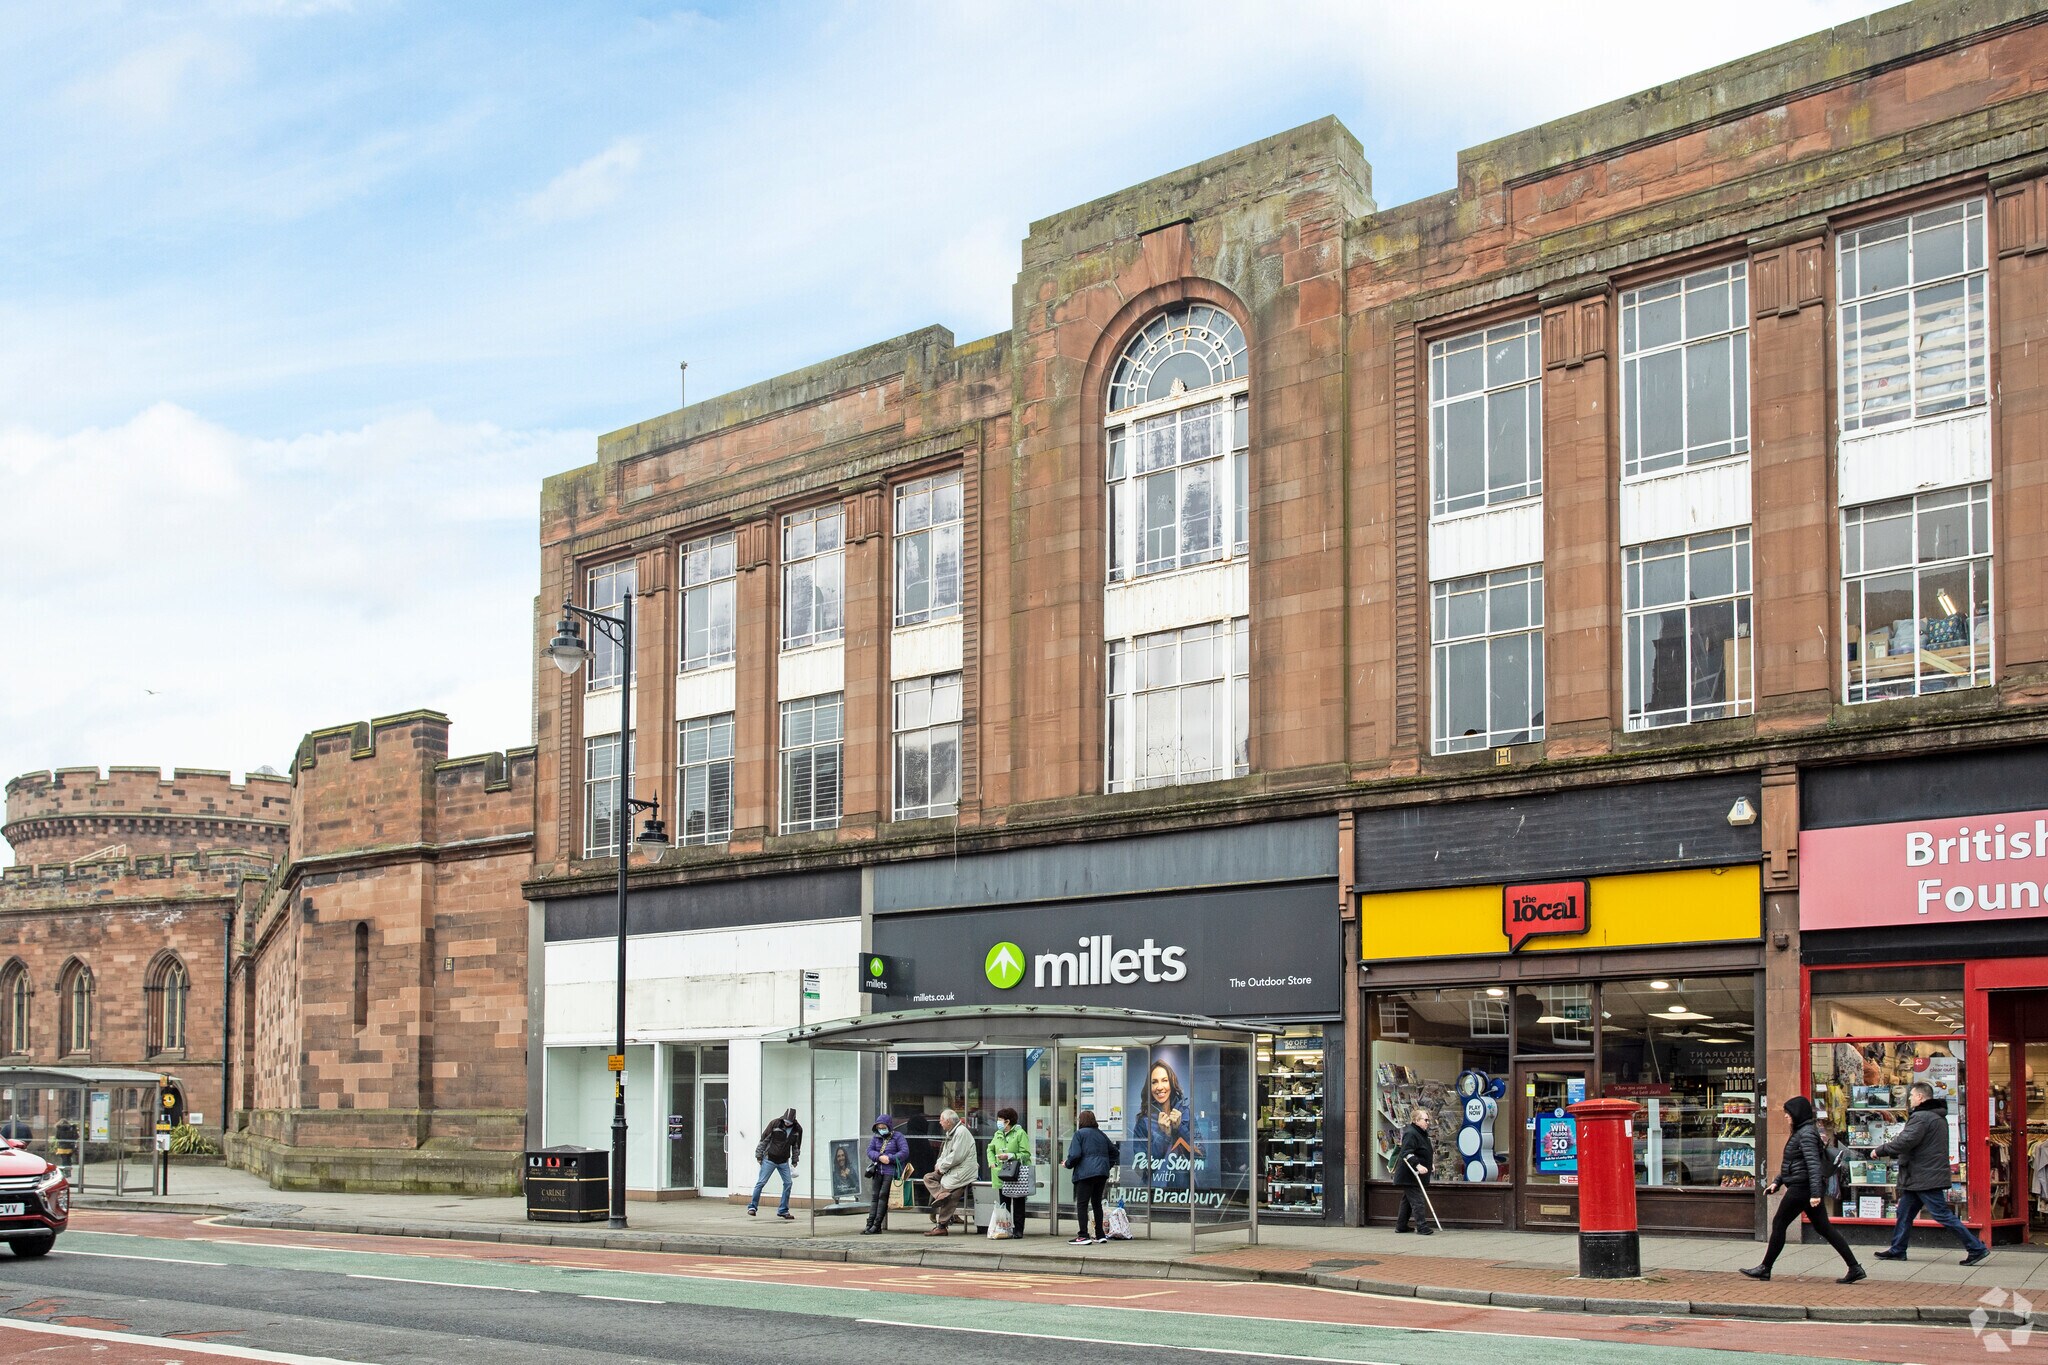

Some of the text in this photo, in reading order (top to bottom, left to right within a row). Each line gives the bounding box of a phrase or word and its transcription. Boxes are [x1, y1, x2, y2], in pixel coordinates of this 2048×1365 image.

[1906, 819, 2048, 867] British
[1521, 895, 1537, 904] the
[1917, 879, 2048, 915] Foun
[1512, 895, 1578, 922] local
[1034, 934, 1187, 988] millets
[865, 979, 888, 989] millets
[1229, 975, 1312, 989] The Outdoor Store
[913, 992, 955, 1002] millets.co.uk
[1551, 1139, 1568, 1150] 30
[1131, 1151, 1166, 1170] Peter
[1152, 1170, 1176, 1182] with
[541, 1187, 566, 1197] CARLISLE
[1117, 1188, 1148, 1204] Julia
